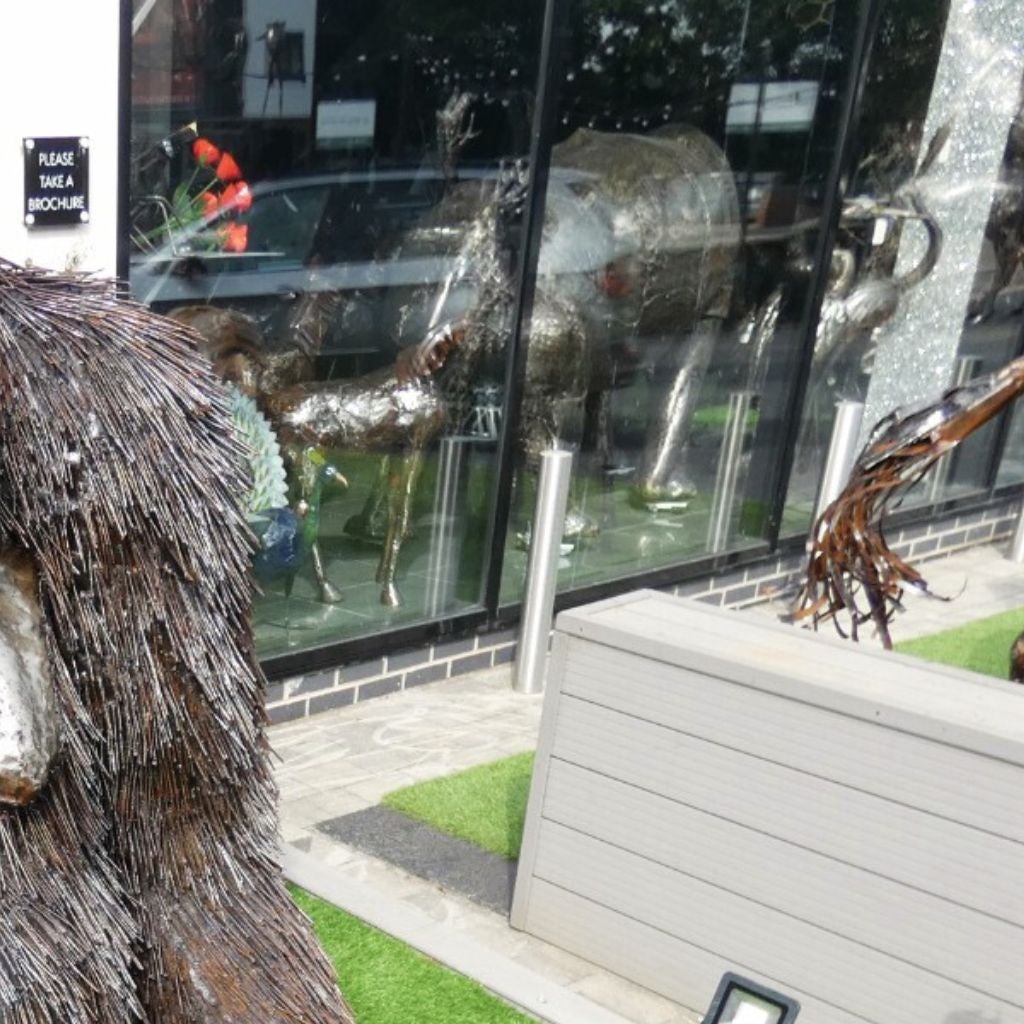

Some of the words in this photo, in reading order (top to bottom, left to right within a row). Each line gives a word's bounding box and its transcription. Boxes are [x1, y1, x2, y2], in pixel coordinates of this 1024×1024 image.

[39, 152, 74, 166] PLEASE
[39, 174, 64, 188] TAKE
[65, 174, 74, 187] A
[28, 195, 85, 211] BROCHURE
